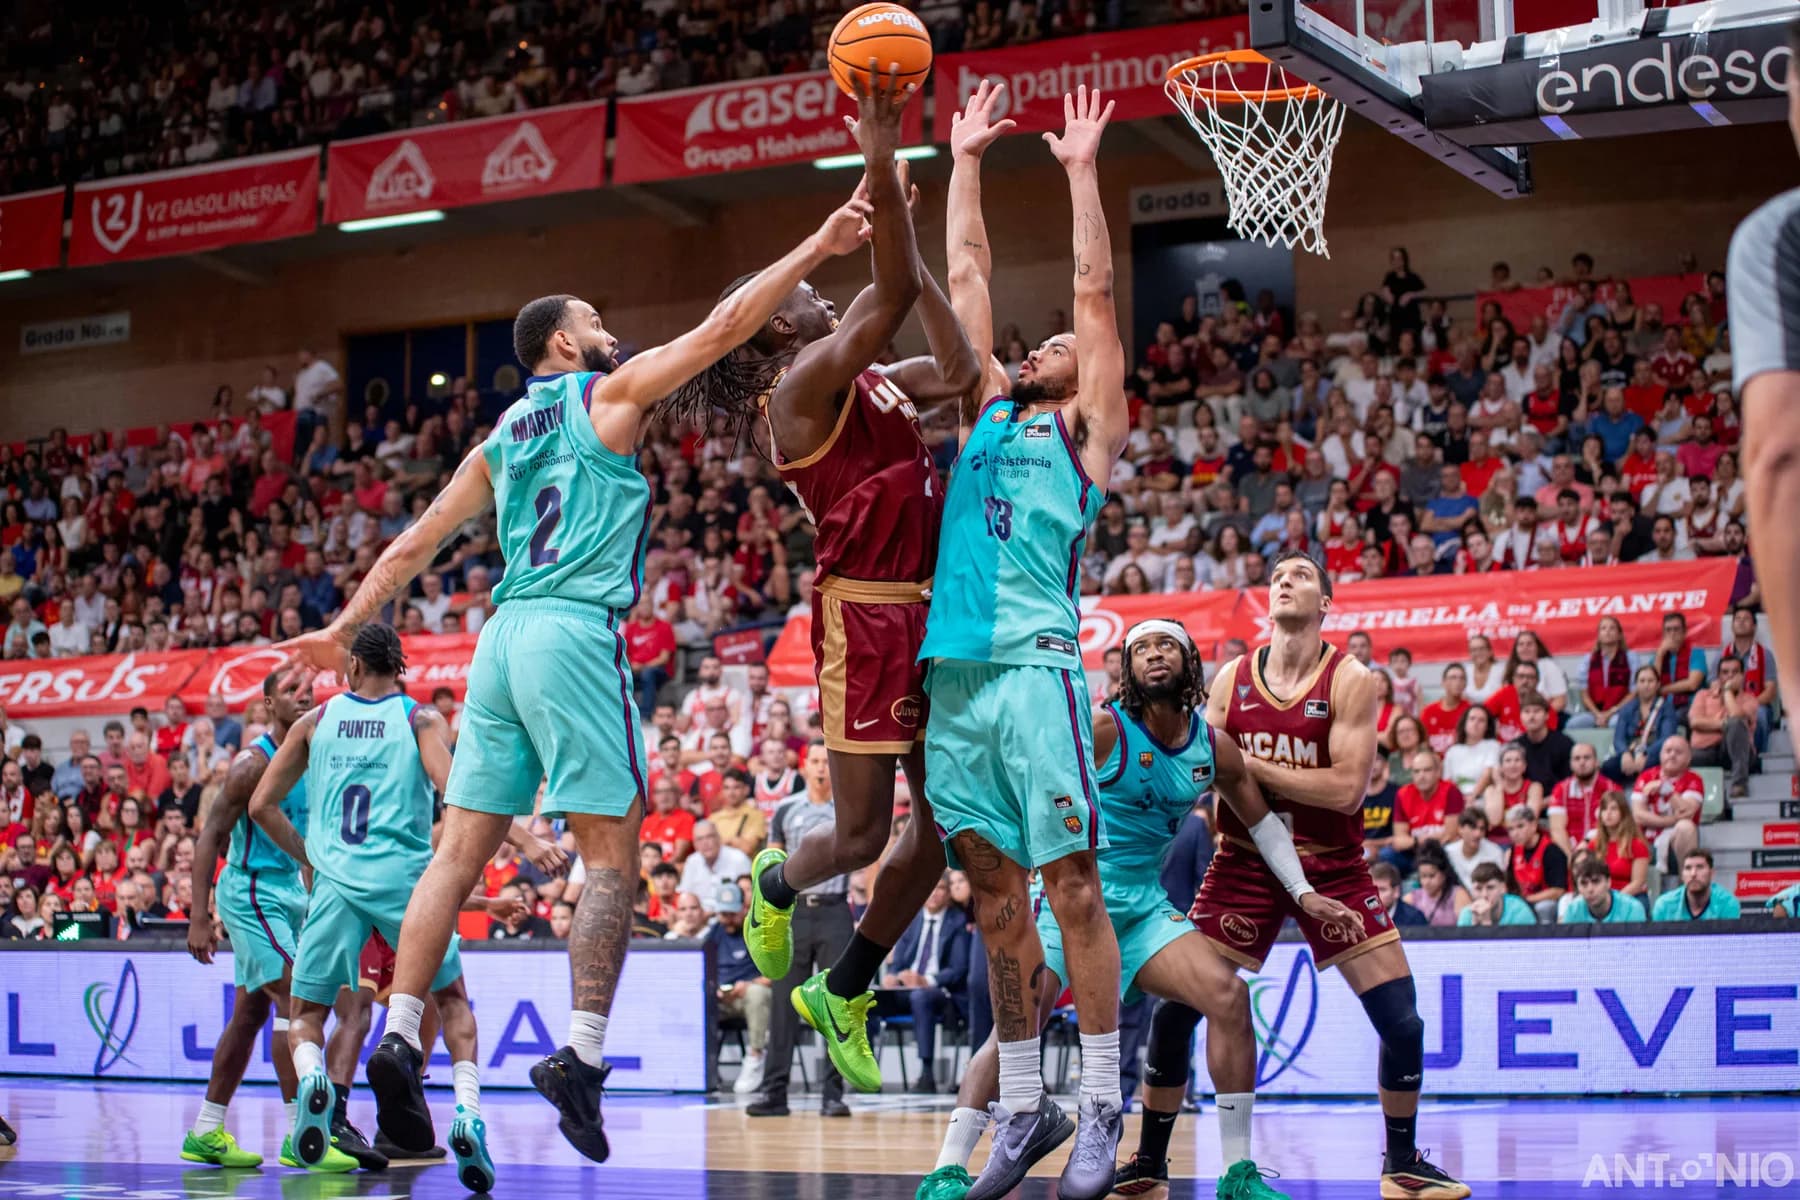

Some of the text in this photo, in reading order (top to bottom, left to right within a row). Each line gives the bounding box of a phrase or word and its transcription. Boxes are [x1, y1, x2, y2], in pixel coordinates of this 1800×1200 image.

[683, 127, 848, 171] Grupo Helvetia
[170, 180, 297, 219] GASOLINERAS
[1137, 190, 1210, 213] Grada
[530, 485, 562, 568] 2
[984, 496, 1013, 542] 13
[1321, 601, 1500, 631] ESTRELLA
[1531, 590, 1708, 622] LEVANTE
[337, 720, 385, 738] PUNTER
[341, 784, 371, 845] 0
[1223, 917, 1255, 940] Juver
[1423, 974, 1798, 1070] JEVE
